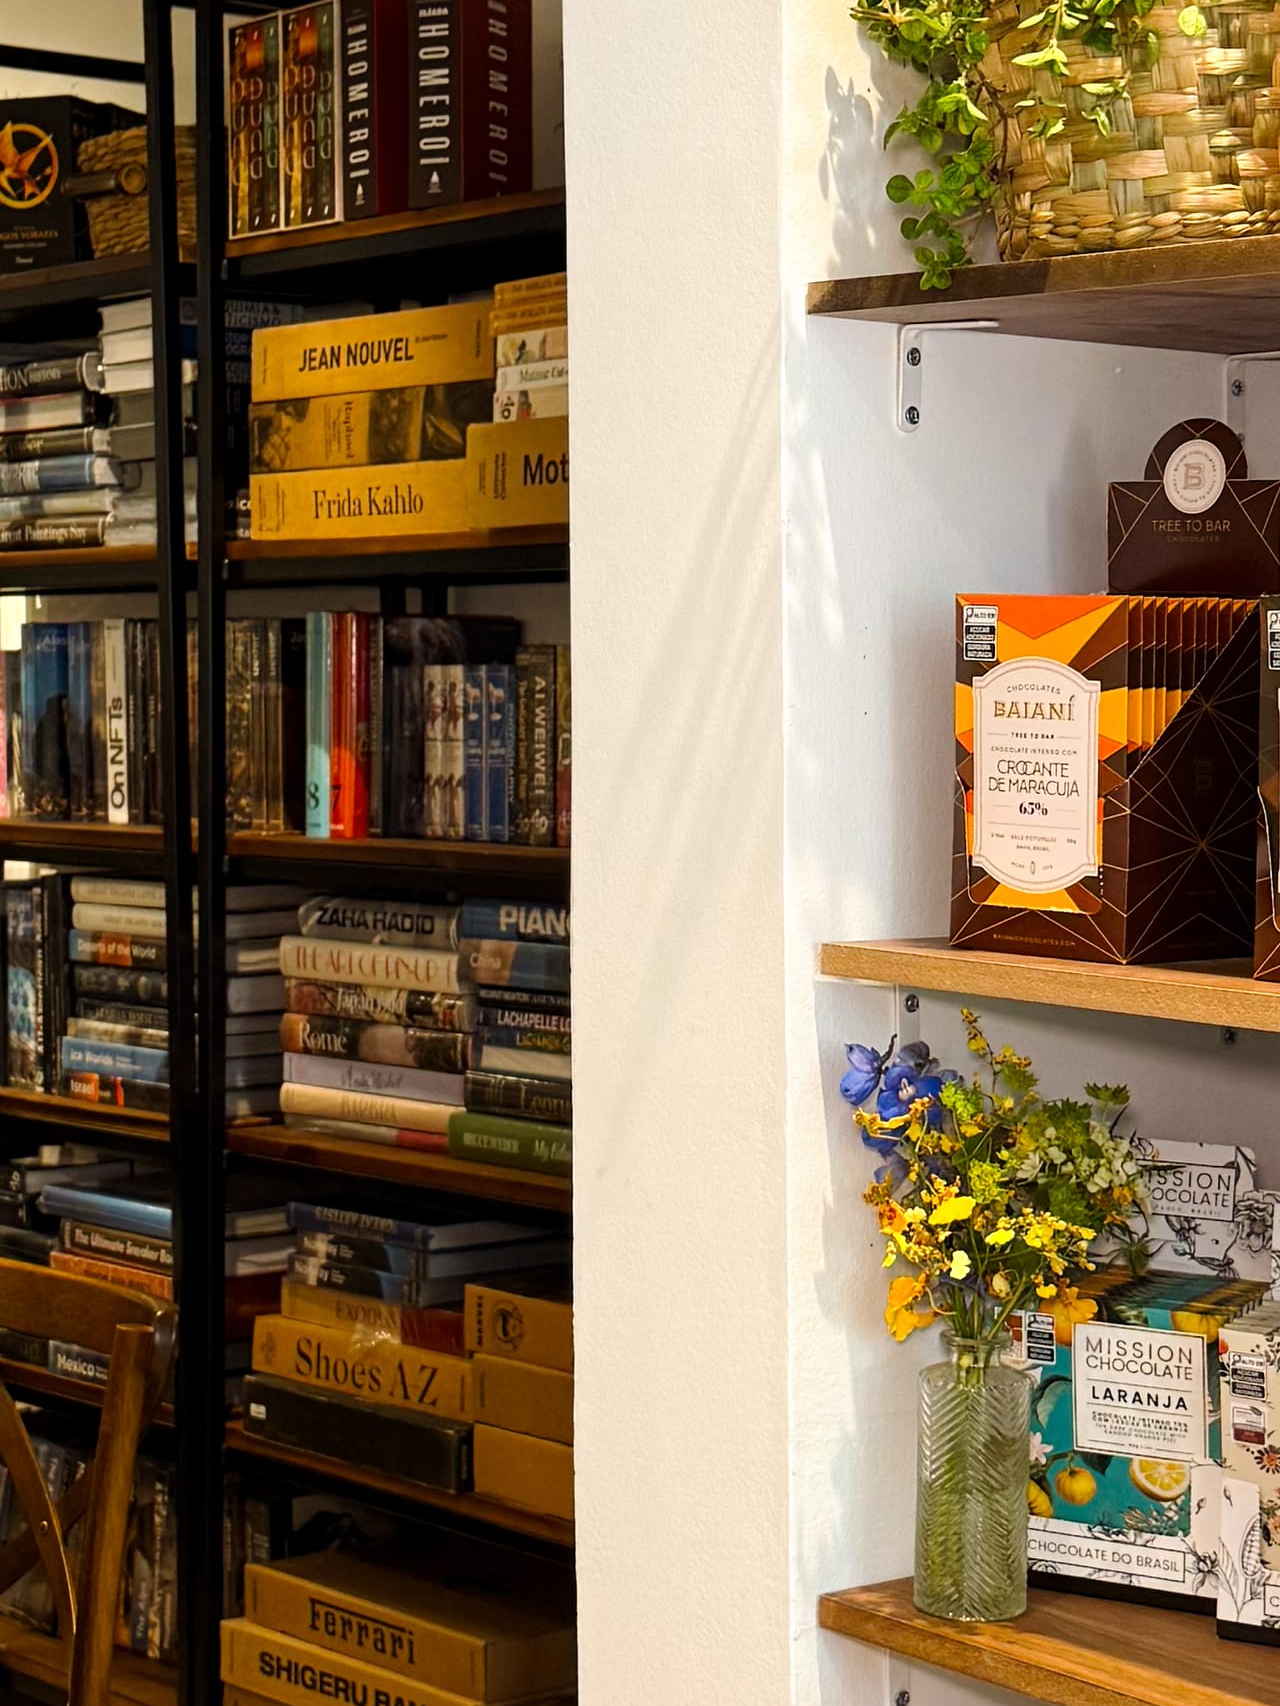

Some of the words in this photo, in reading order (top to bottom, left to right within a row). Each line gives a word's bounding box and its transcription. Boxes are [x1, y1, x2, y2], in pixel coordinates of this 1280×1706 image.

[298, 344, 342, 373] JEAN
[345, 337, 414, 369] NOUVEL
[314, 489, 363, 520] Frida
[367, 484, 424, 517] Kahlo
[1152, 520, 1181, 533] TREE
[1186, 520, 1202, 532] TO
[1206, 520, 1231, 532] BAR
[534, 676, 546, 700] AI
[1006, 683, 1062, 695] CHOCOLATES
[993, 694, 1076, 721] BAIANÍ
[534, 703, 546, 796] WEIWEI
[997, 759, 1069, 778] CROCANTE
[307, 782, 319, 811] 8
[1018, 800, 1049, 816] 65%
[316, 906, 367, 931] ZAHA
[372, 911, 435, 936] HADID
[298, 1021, 348, 1053] Rome
[1086, 1336, 1192, 1364] MISSION
[57, 1353, 95, 1376] Mexico
[294, 1336, 382, 1394] Shoes
[389, 1359, 439, 1408] A-Z
[1086, 1355, 1193, 1380] CHOCOLATE
[1092, 1386, 1187, 1411] LARANJA
[1028, 1539, 1110, 1563] CHOCOLATE
[1111, 1545, 1133, 1567] DO
[1136, 1549, 1180, 1574] BRASIL
[308, 1596, 416, 1665] Ferrari
